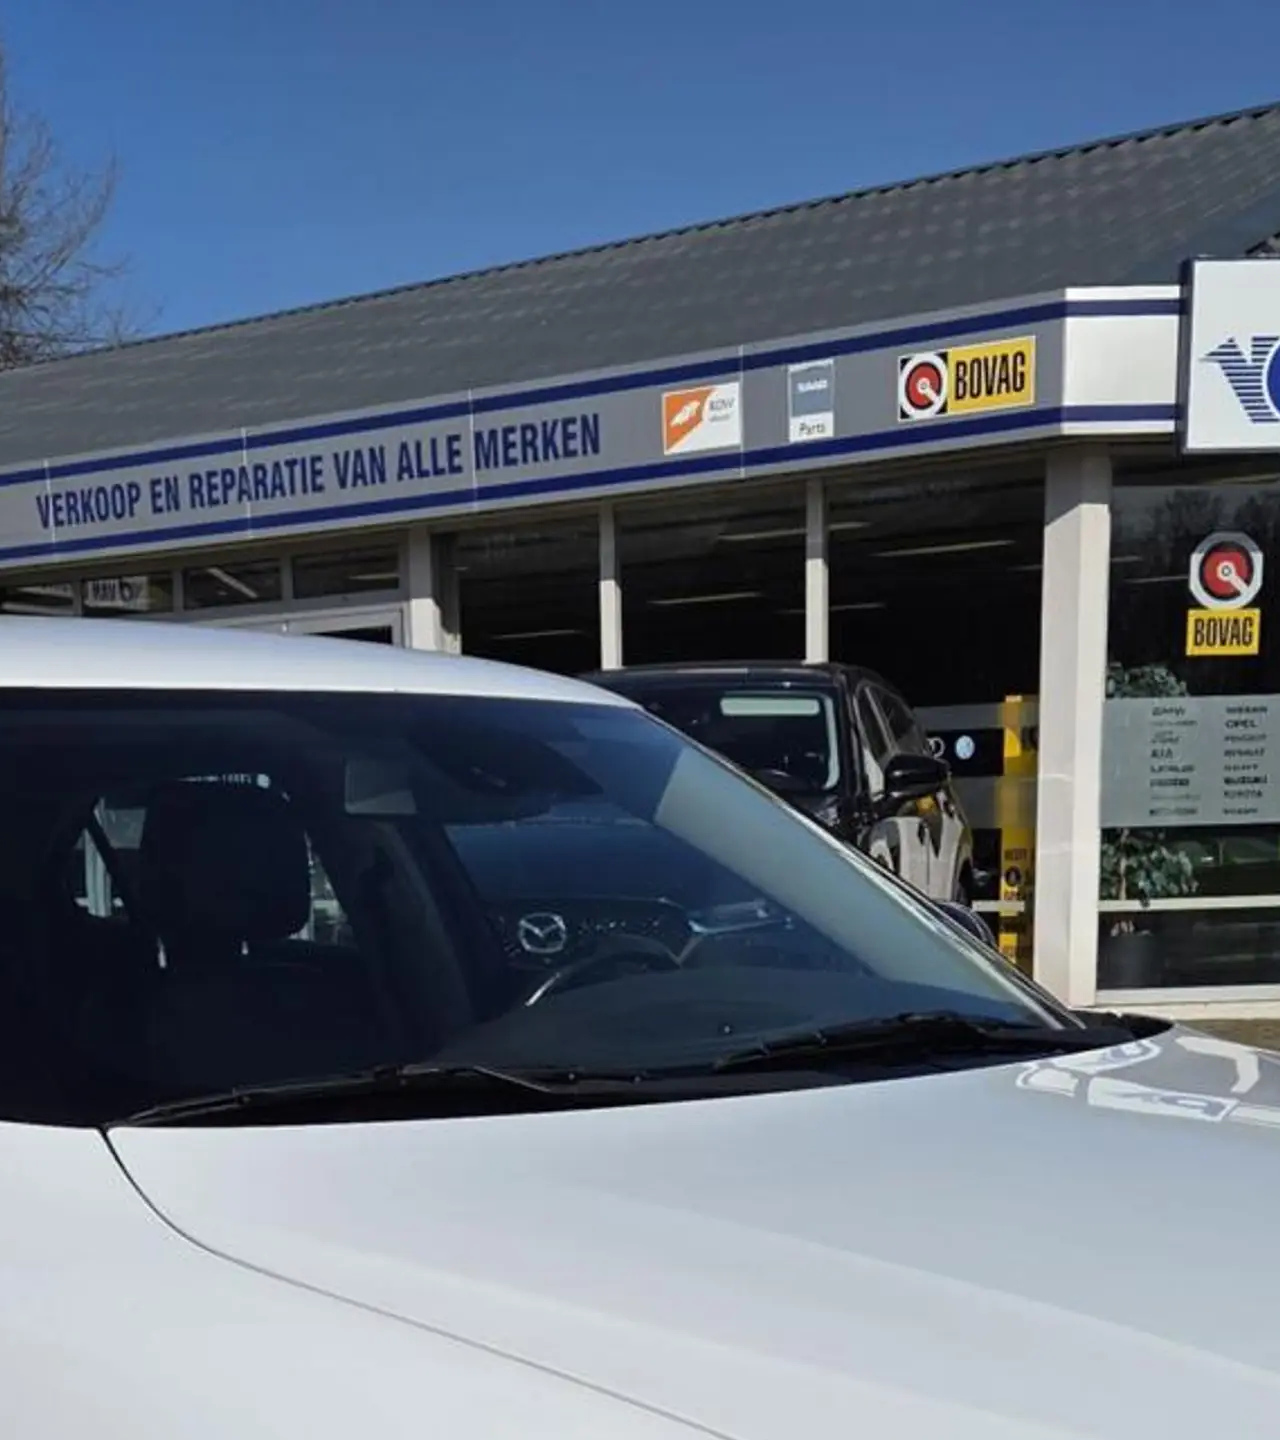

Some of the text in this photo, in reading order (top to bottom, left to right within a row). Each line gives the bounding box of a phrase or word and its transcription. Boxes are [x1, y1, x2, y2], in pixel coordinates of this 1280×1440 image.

[955, 351, 1026, 401] BOVAG
[36, 412, 601, 530] VERKOOP EN REPARATIE VAN ALLE MERKEN
[1194, 617, 1254, 647] BOVAG
